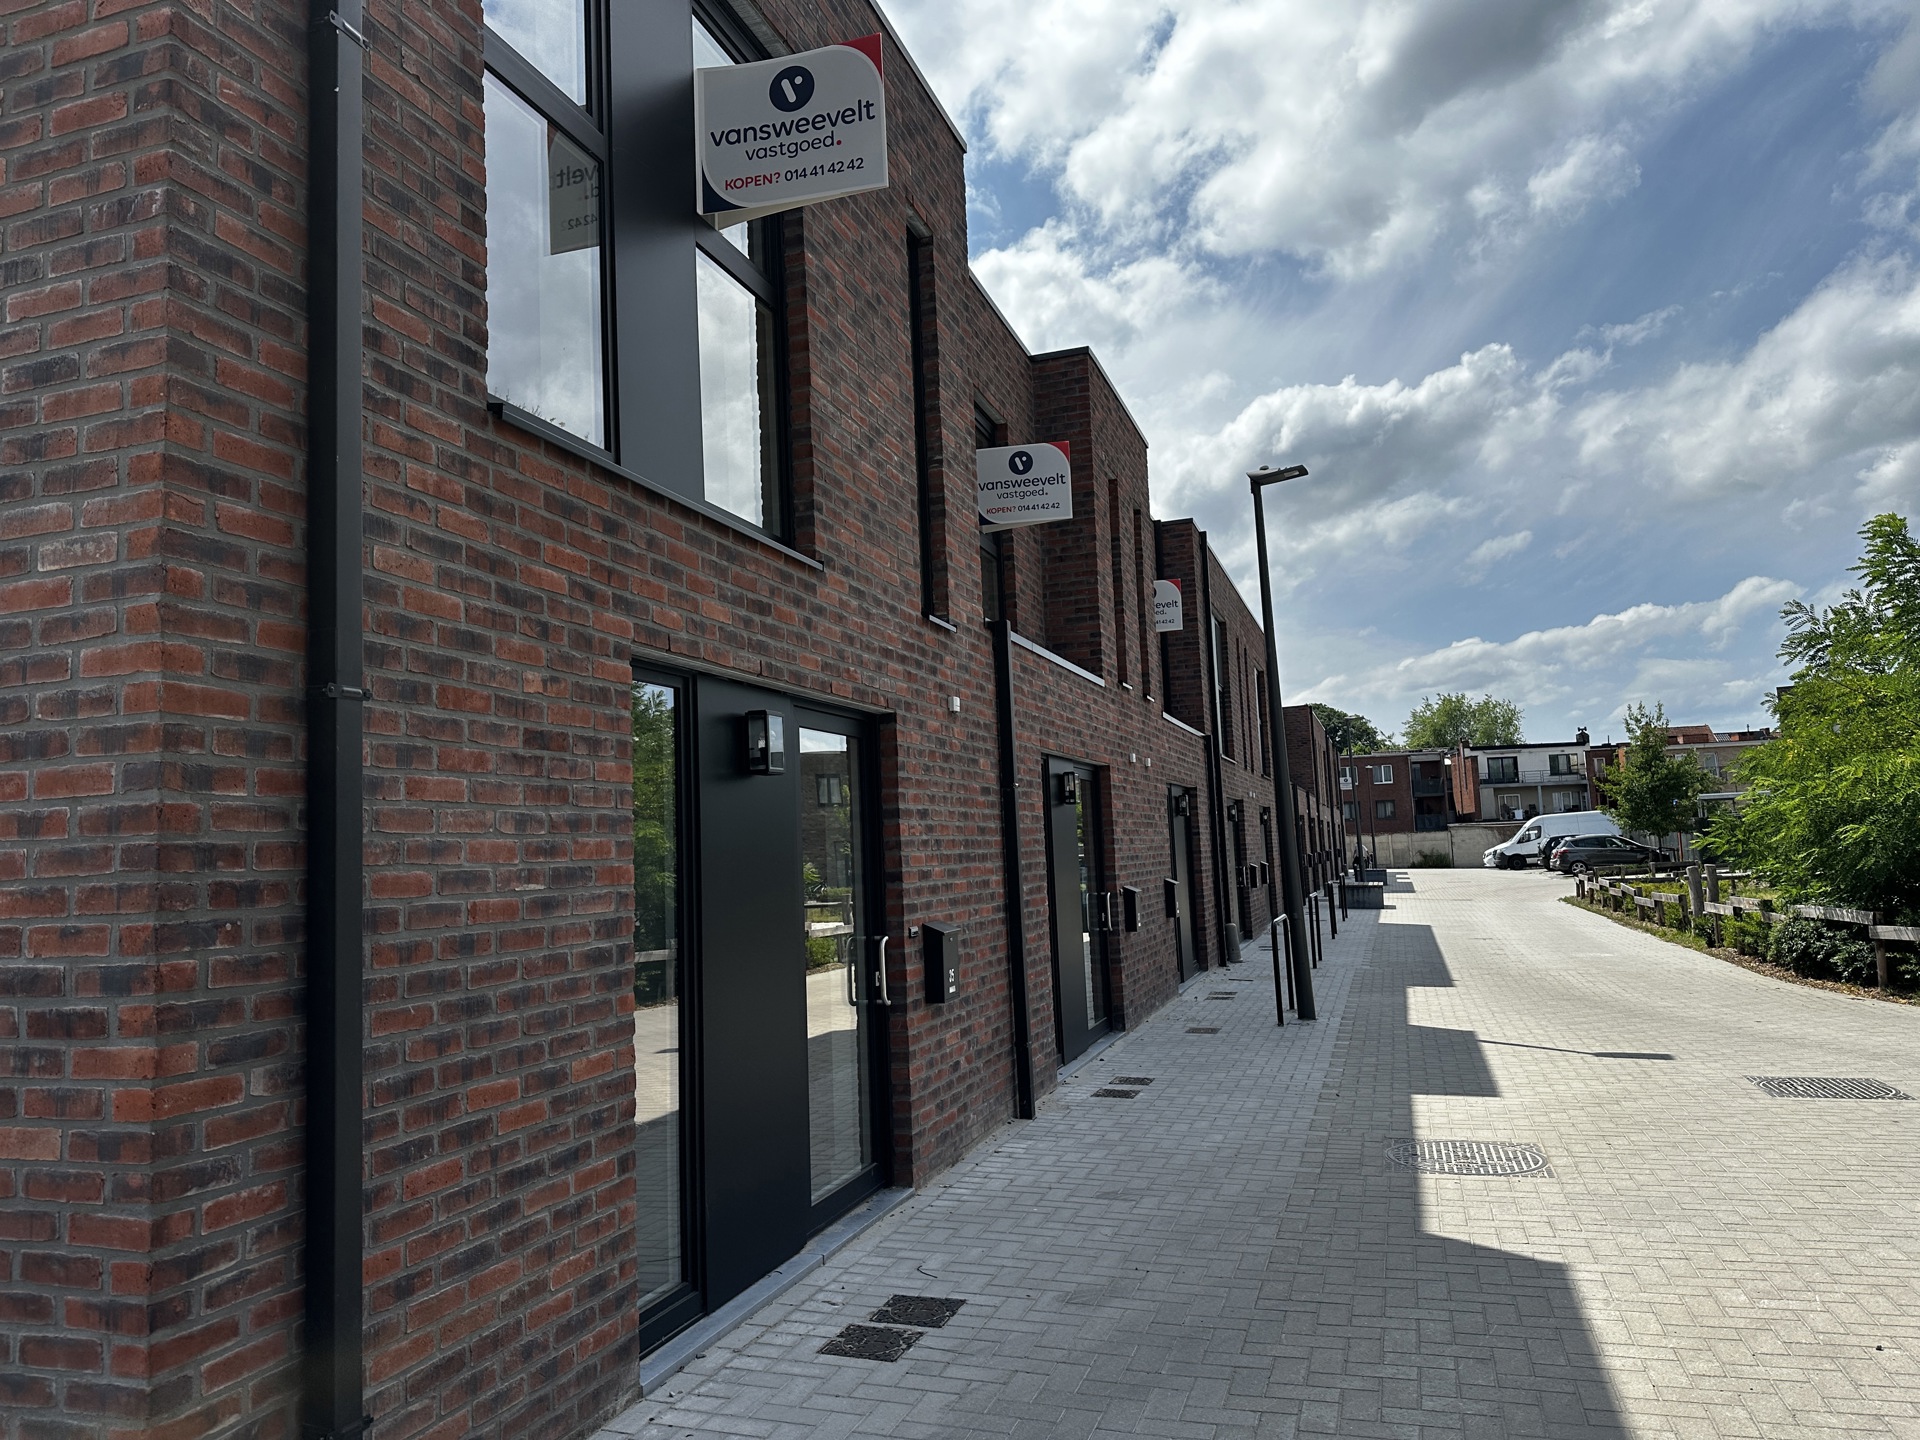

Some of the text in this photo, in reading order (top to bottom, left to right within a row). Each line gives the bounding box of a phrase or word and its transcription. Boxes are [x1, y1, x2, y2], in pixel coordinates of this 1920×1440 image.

[710, 99, 876, 147] vansweevelt
[745, 131, 842, 161] vastgoed.
[725, 172, 781, 190] KOPEN?
[978, 473, 1066, 491] vansweevelt
[996, 487, 1049, 500] vastgoed.
[986, 506, 1016, 514] KOPEN?
